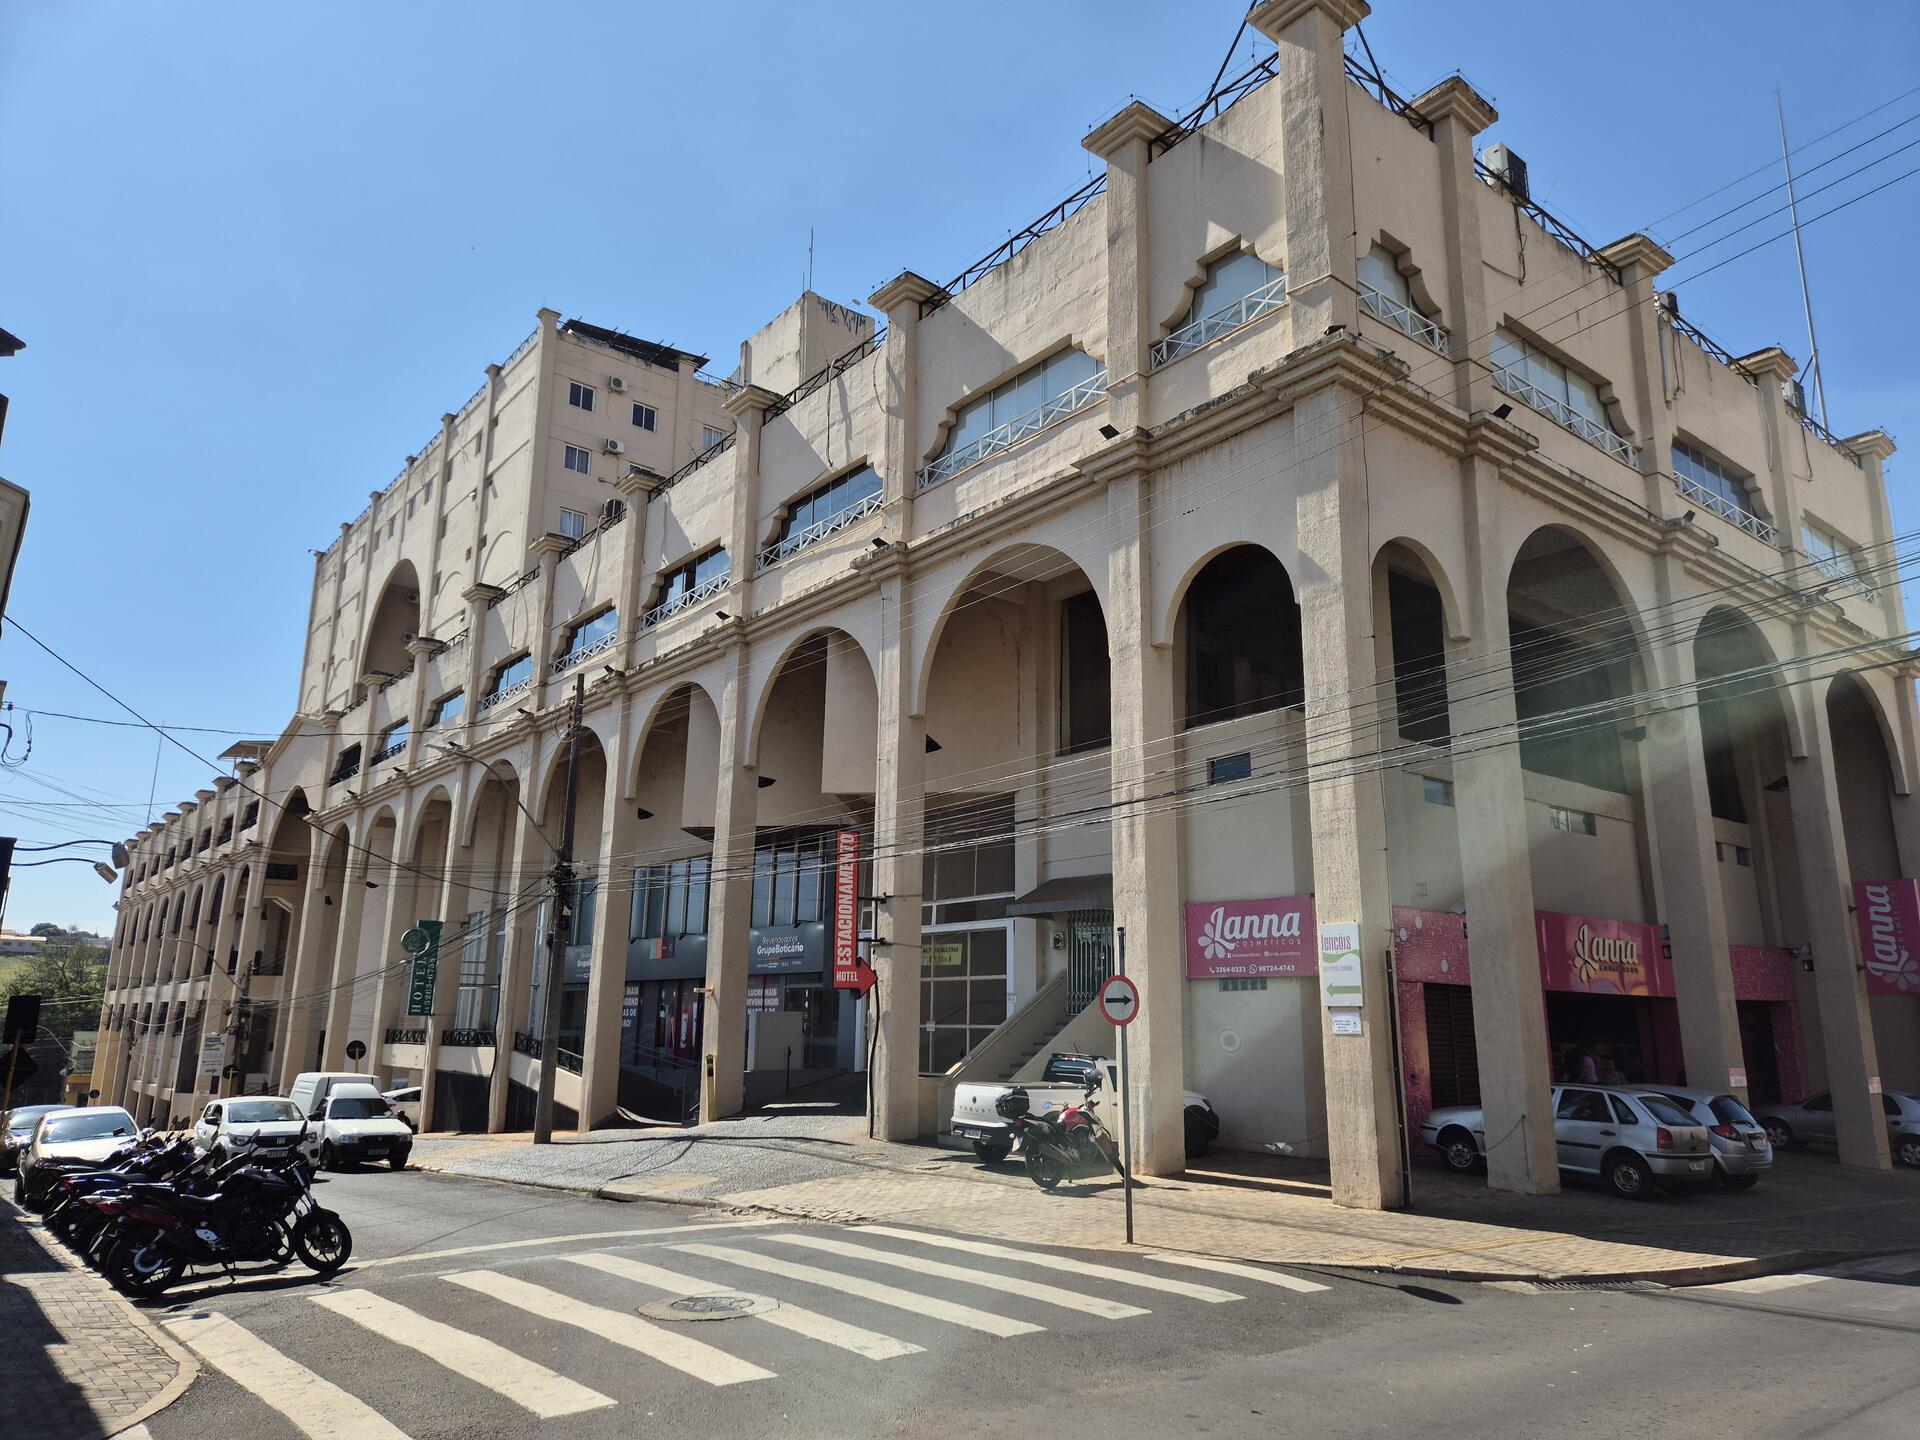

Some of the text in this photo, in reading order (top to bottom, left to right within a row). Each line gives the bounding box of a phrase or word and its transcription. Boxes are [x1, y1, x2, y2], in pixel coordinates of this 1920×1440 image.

[836, 832, 855, 966] ESTACIONAMENTO
[756, 942, 804, 956] GrupoBoticário
[762, 935, 799, 945] Revendedores
[1210, 907, 1301, 950] Lanna
[1235, 938, 1301, 947] COSMÉTICOS
[1579, 924, 1639, 971] Lanna
[1866, 885, 1909, 976] Lanna
[411, 958, 427, 1013] HOTEL
[836, 971, 859, 982] HOTEL
